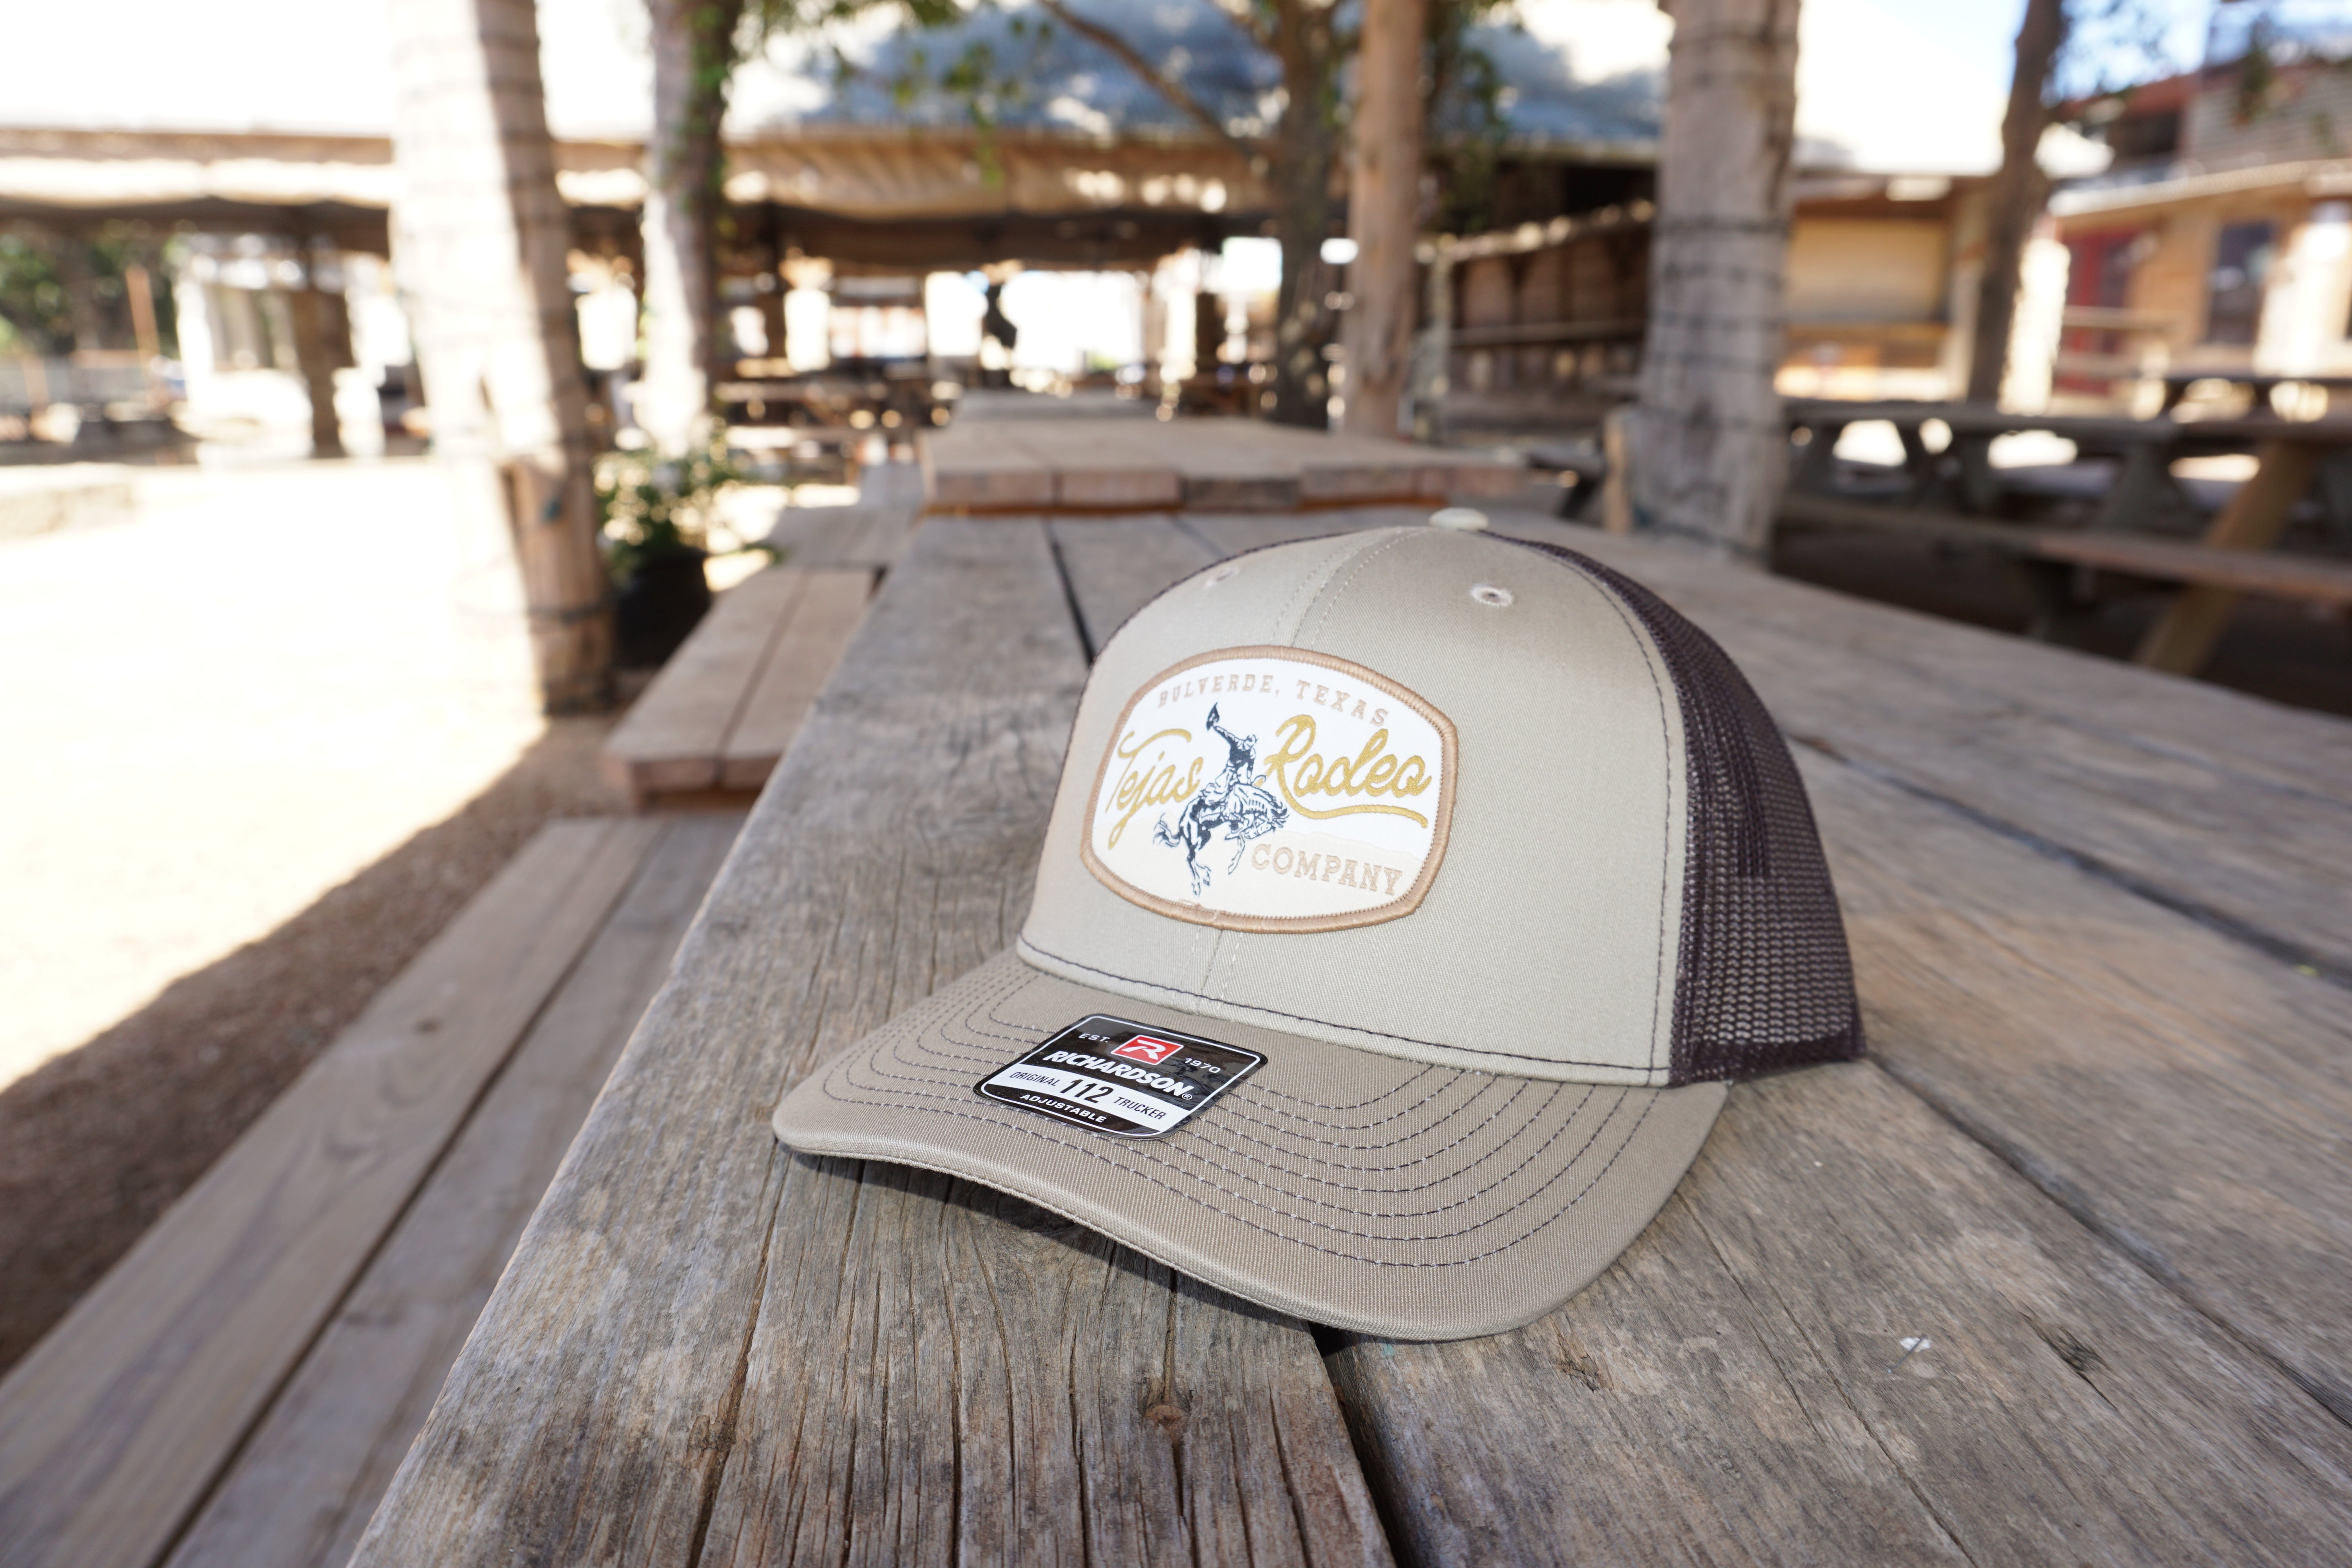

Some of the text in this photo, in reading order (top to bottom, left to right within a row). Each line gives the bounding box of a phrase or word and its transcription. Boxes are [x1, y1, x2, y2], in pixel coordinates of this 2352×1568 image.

[1158, 674, 1389, 726] BULVERDE, TEXAS
[1105, 714, 1432, 851] Tejas Rodeo
[1251, 844, 1403, 896] COMPANY
[1078, 1032, 1108, 1043] EST.
[1184, 1057, 1221, 1074] 1970
[1009, 1071, 1167, 1120] ORIGINAL 112 TRUCKER
[1019, 1094, 1107, 1123] ADJUSTABLE
